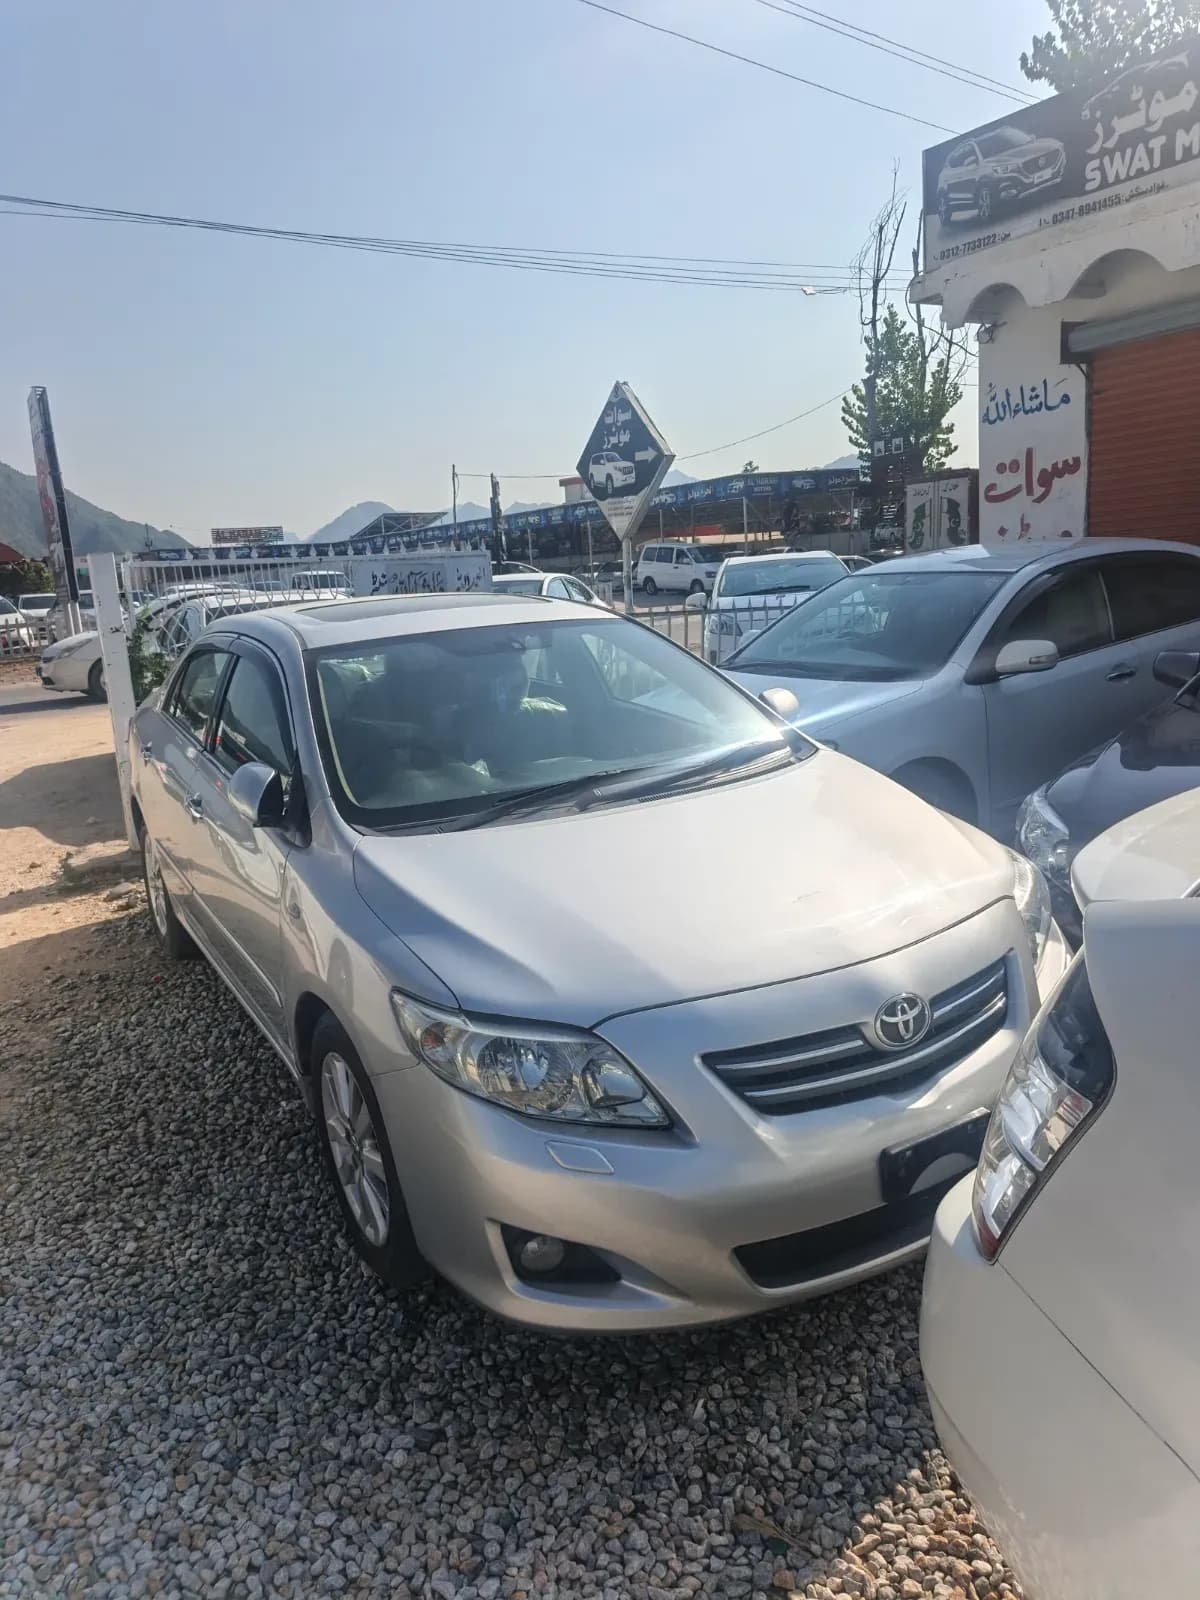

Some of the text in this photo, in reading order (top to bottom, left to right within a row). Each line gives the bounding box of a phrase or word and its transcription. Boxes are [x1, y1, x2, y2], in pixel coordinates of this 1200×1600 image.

[1086, 80, 1199, 154] موٹرز
[1084, 135, 1168, 192] SWAT
[604, 406, 632, 426] سوات
[983, 447, 1082, 504] سوات
